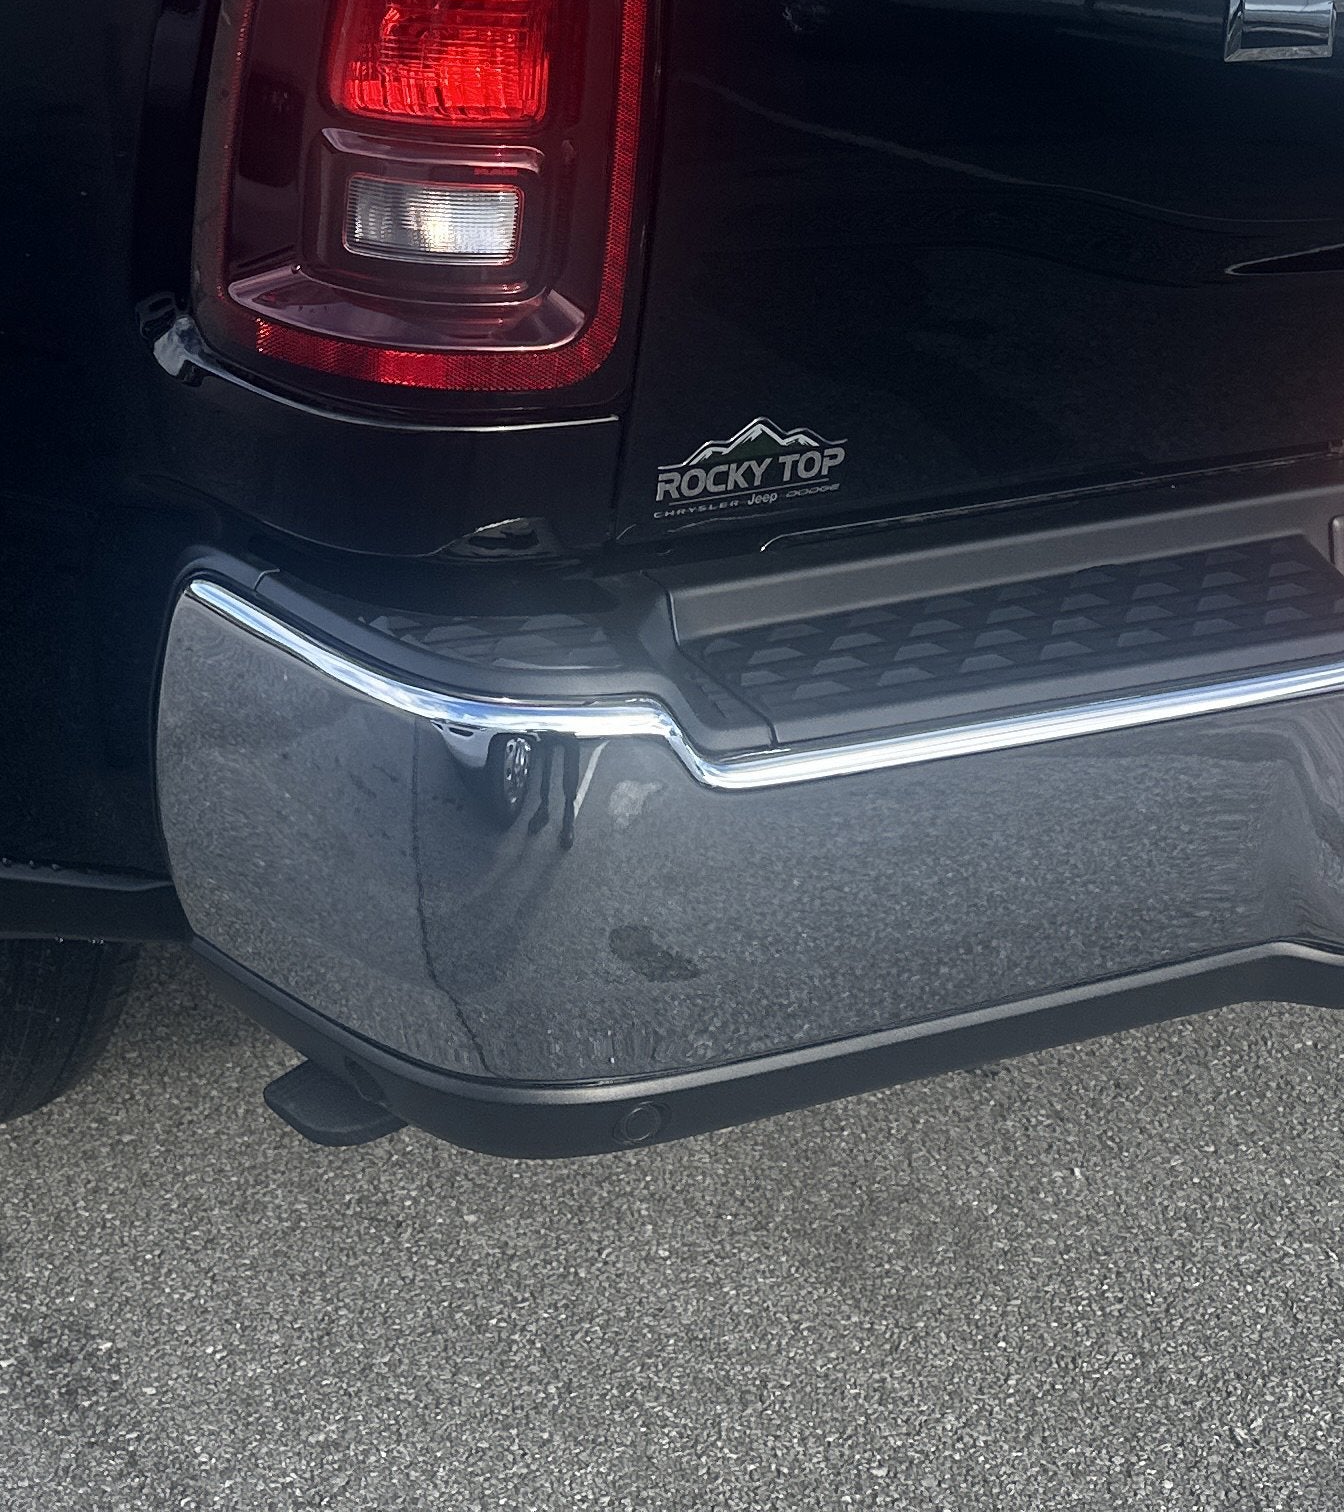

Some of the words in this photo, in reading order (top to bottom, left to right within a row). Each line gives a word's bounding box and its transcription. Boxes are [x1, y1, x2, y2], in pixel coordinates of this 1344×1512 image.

[656, 458, 773, 502] ROCKY
[778, 447, 846, 482] TOP
[654, 499, 739, 519] CHRYSLER
[747, 491, 778, 506] Jeep
